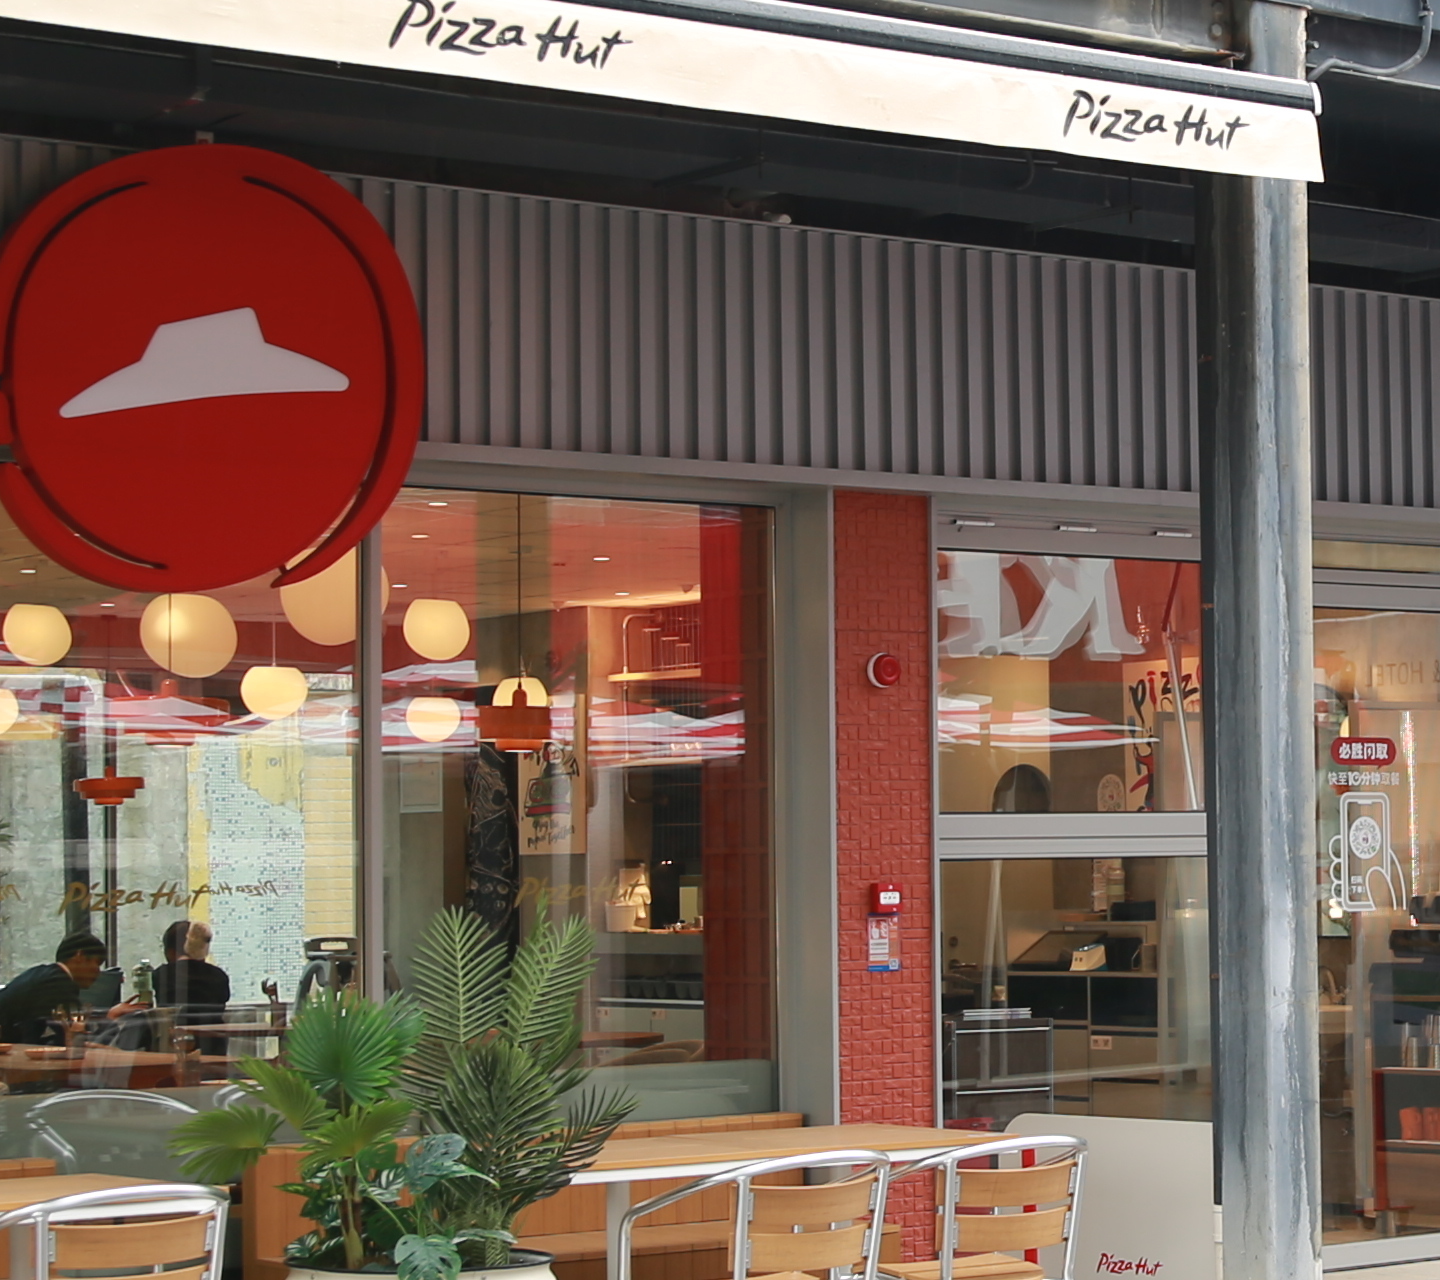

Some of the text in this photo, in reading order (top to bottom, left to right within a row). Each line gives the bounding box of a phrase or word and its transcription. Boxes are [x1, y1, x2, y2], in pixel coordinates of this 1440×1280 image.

[533, 16, 636, 70] Hut
[1061, 89, 1251, 153] Pizza Hut
[1338, 742, 1389, 760] 必胜闪取
[58, 880, 210, 915] Pizza Hut
[514, 877, 588, 908] Pizza
[1096, 1252, 1164, 1277] Pizza Hut
